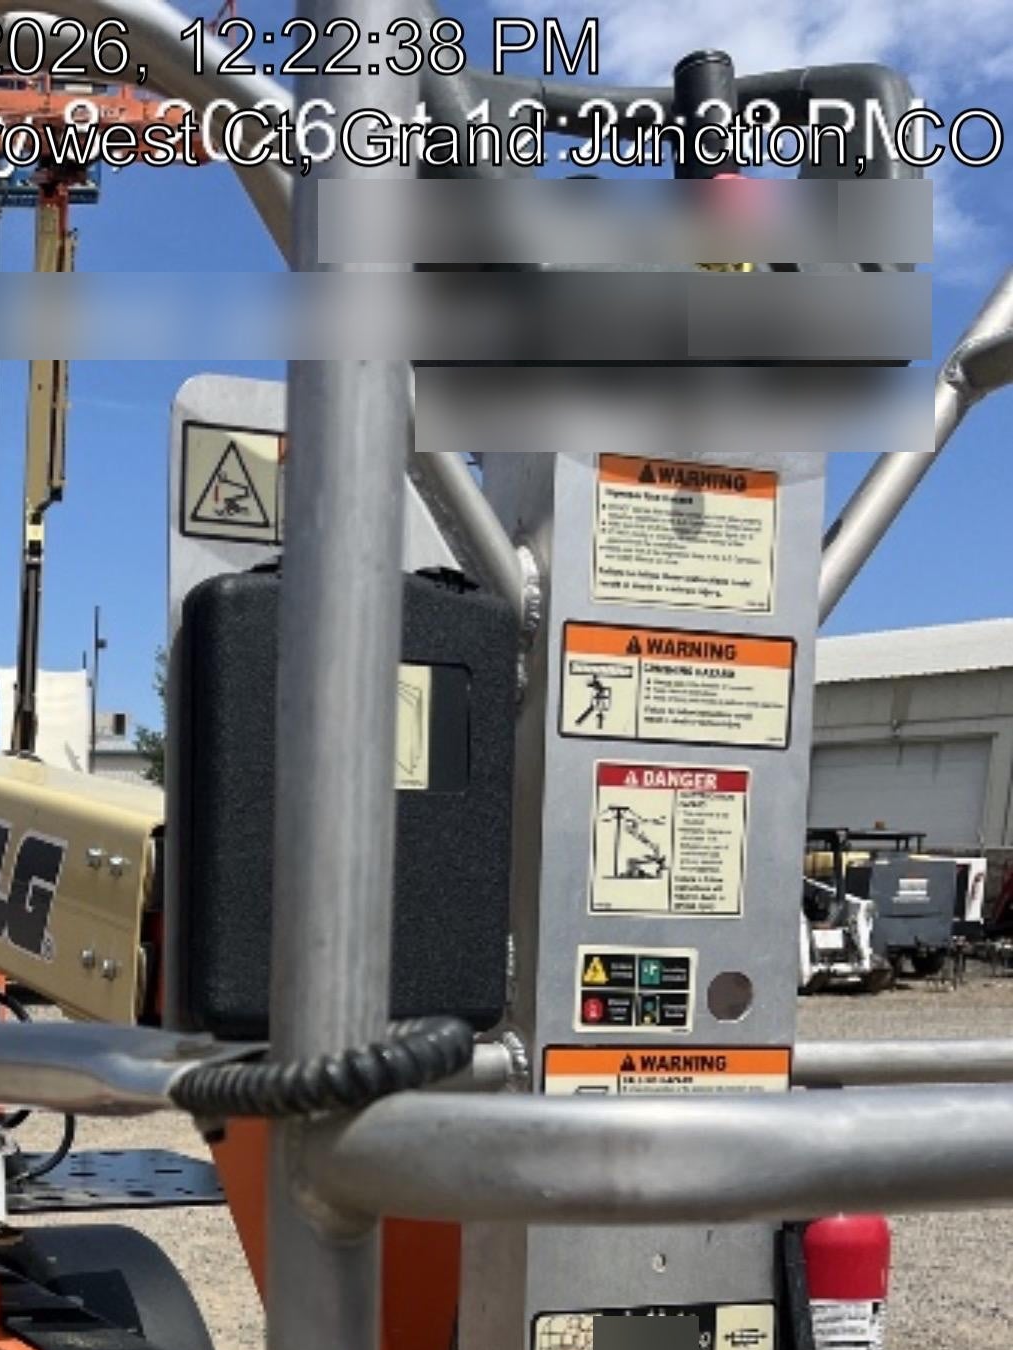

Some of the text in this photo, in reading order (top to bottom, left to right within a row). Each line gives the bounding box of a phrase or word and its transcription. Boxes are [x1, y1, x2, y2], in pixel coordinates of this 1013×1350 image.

[659, 466, 748, 493] WARNING
[646, 637, 736, 661] WARNING
[643, 769, 718, 790] DANGER
[640, 1054, 727, 1072] WARNING
